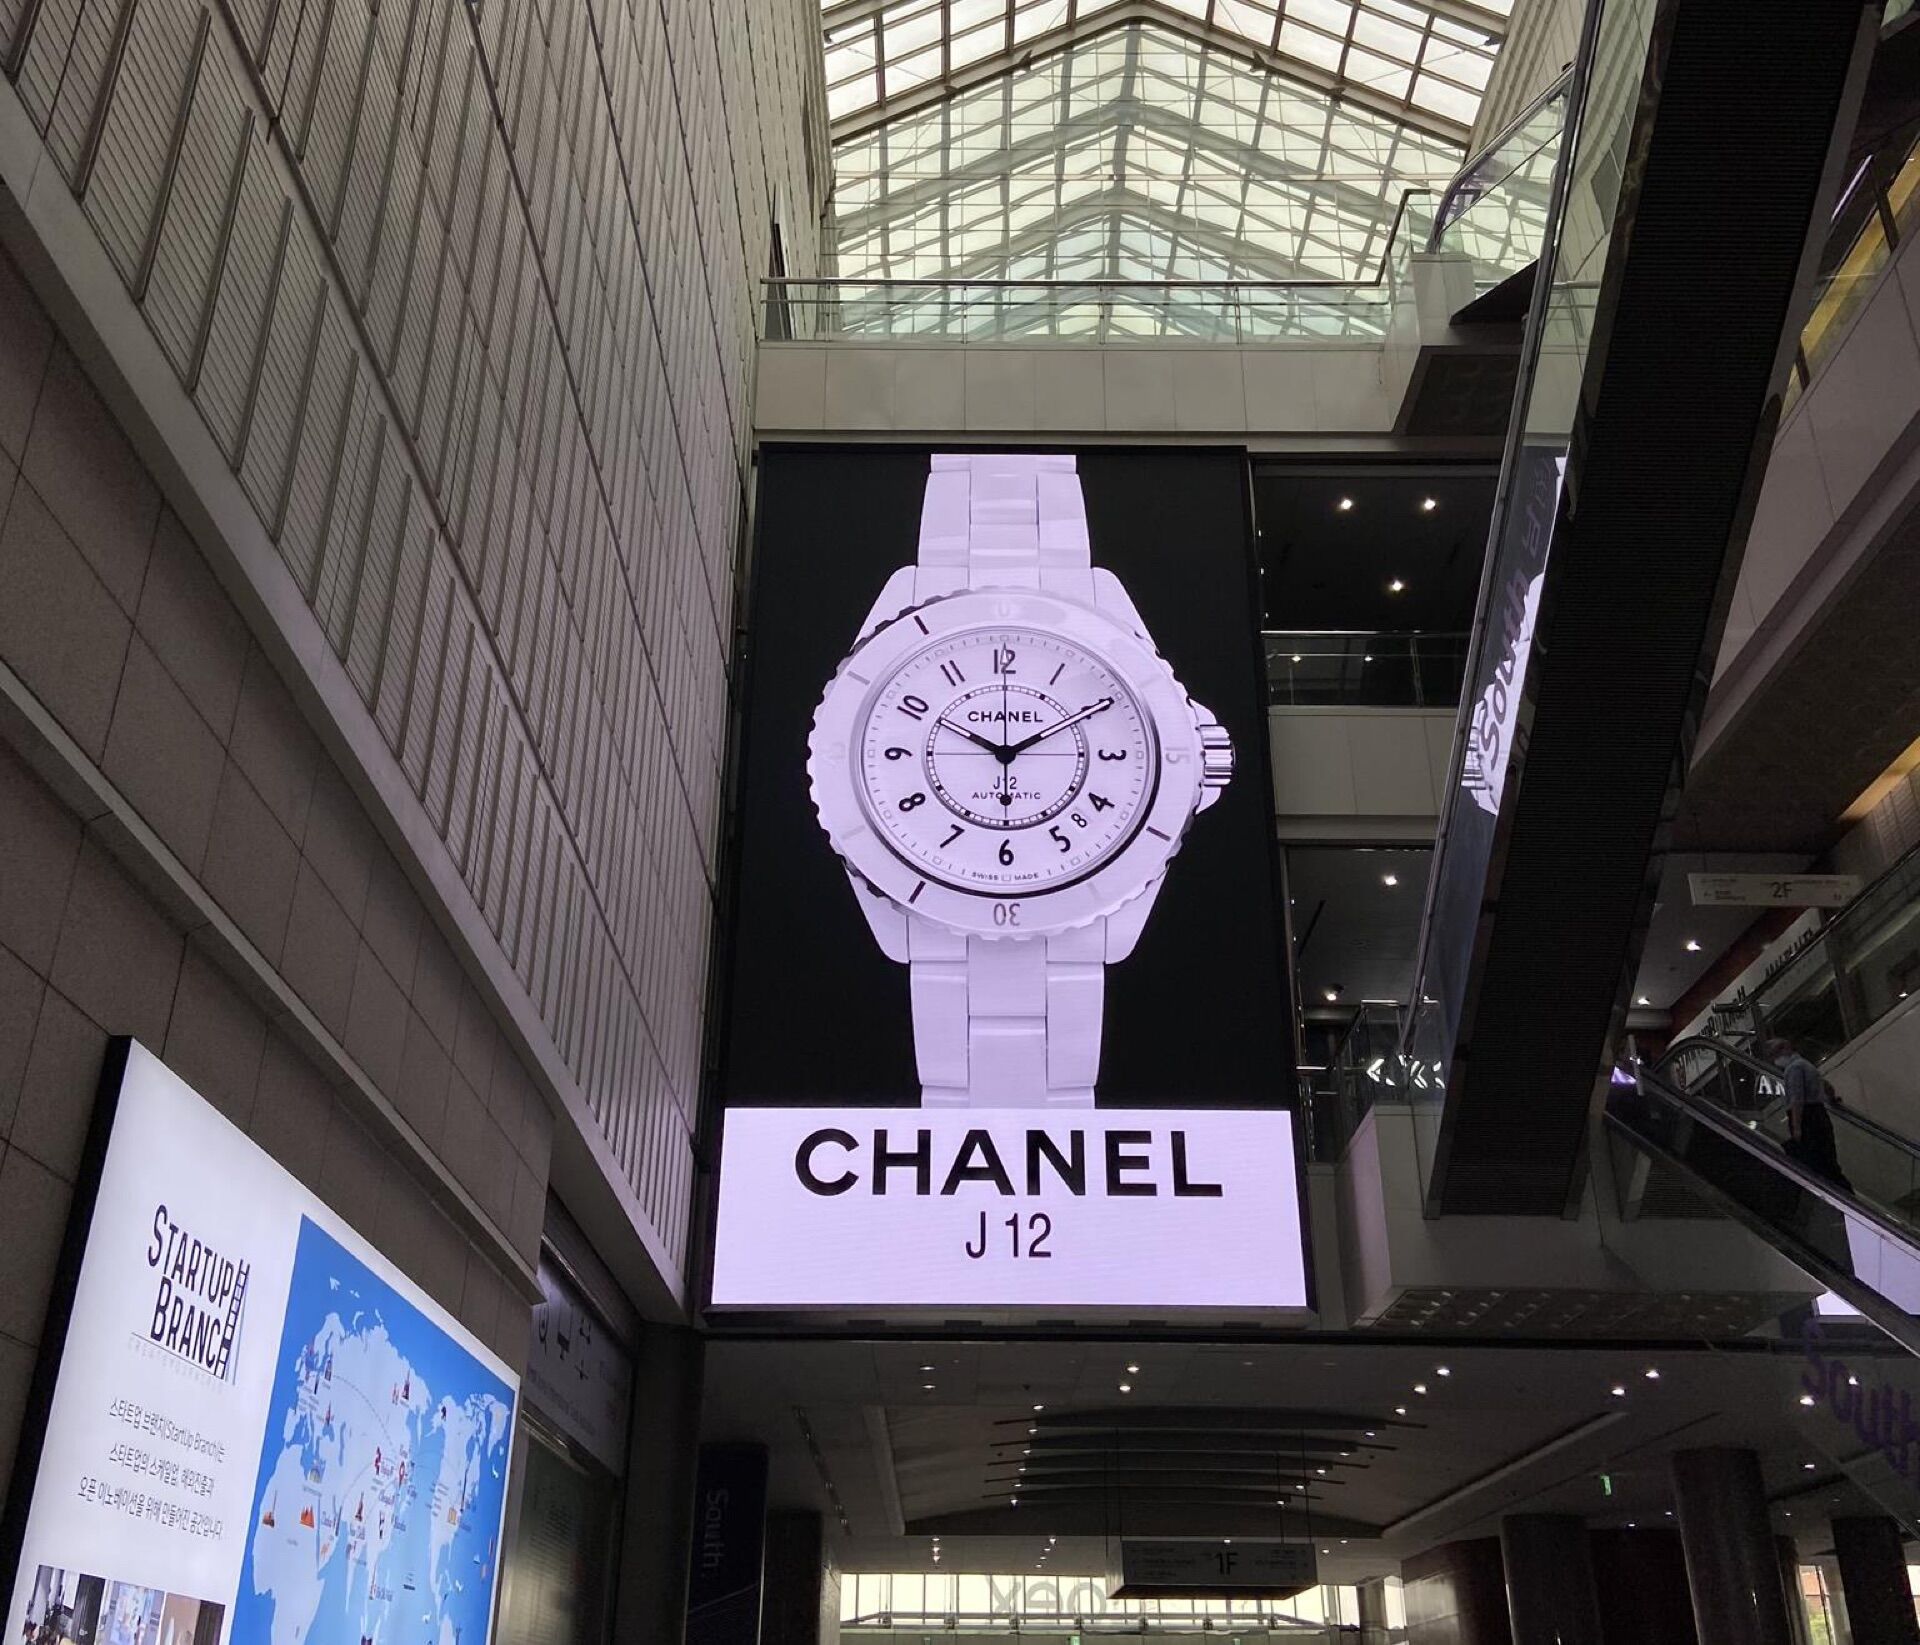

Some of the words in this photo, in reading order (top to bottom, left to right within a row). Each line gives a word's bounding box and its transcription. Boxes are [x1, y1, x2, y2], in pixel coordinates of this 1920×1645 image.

[994, 648, 1017, 675] 12
[897, 695, 930, 722] 10
[968, 711, 1044, 723] CHANEL
[993, 775, 1018, 790] J2
[899, 793, 926, 812] 8
[1088, 792, 1116, 812] 4
[1071, 813, 1088, 829] 8
[939, 824, 965, 849] 7
[1049, 825, 1071, 853] 5
[998, 839, 1015, 866] 6
[1771, 881, 1793, 899] 2F
[795, 1127, 1224, 1198] CHANEL
[147, 1204, 234, 1309] STARTUP
[1213, 1552, 1238, 1576] 1F
